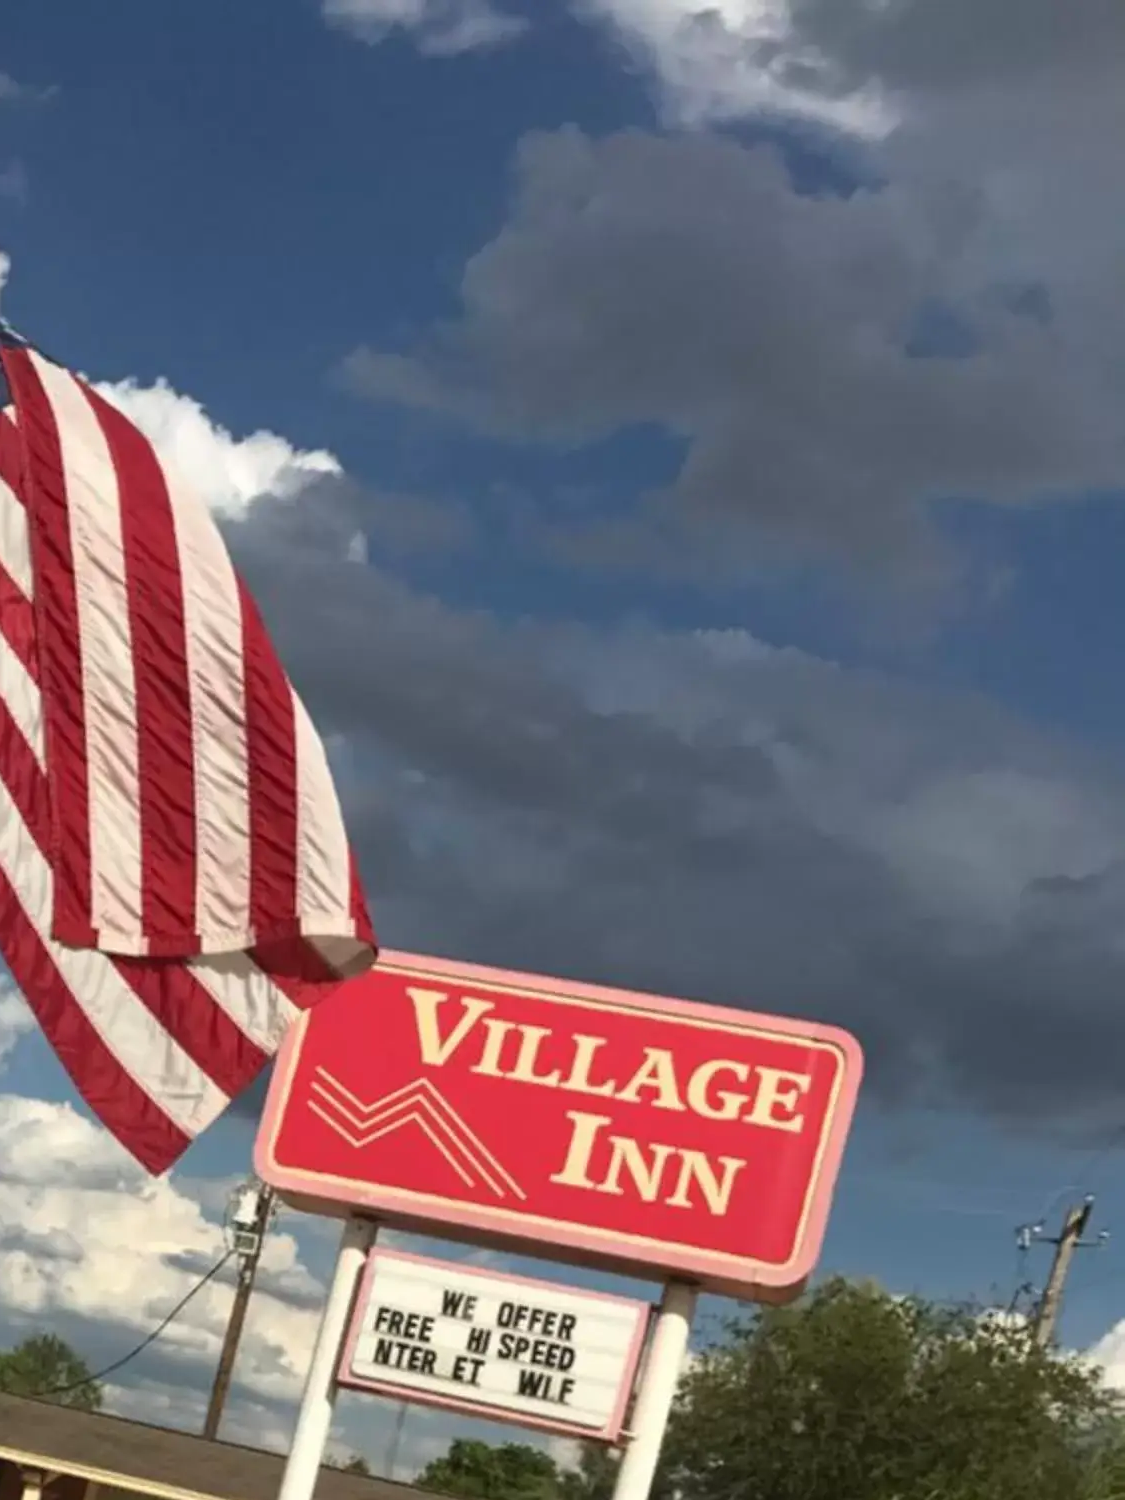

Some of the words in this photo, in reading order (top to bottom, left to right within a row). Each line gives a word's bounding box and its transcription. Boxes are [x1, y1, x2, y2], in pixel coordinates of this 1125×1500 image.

[405, 987, 812, 1132] VILLAGE
[550, 1111, 745, 1215] INN
[374, 1306, 435, 1342] FREE
[466, 1327, 492, 1355] HI
[498, 1334, 575, 1372] SPEED
[441, 1289, 478, 1322] WE
[497, 1302, 577, 1341] OFFER
